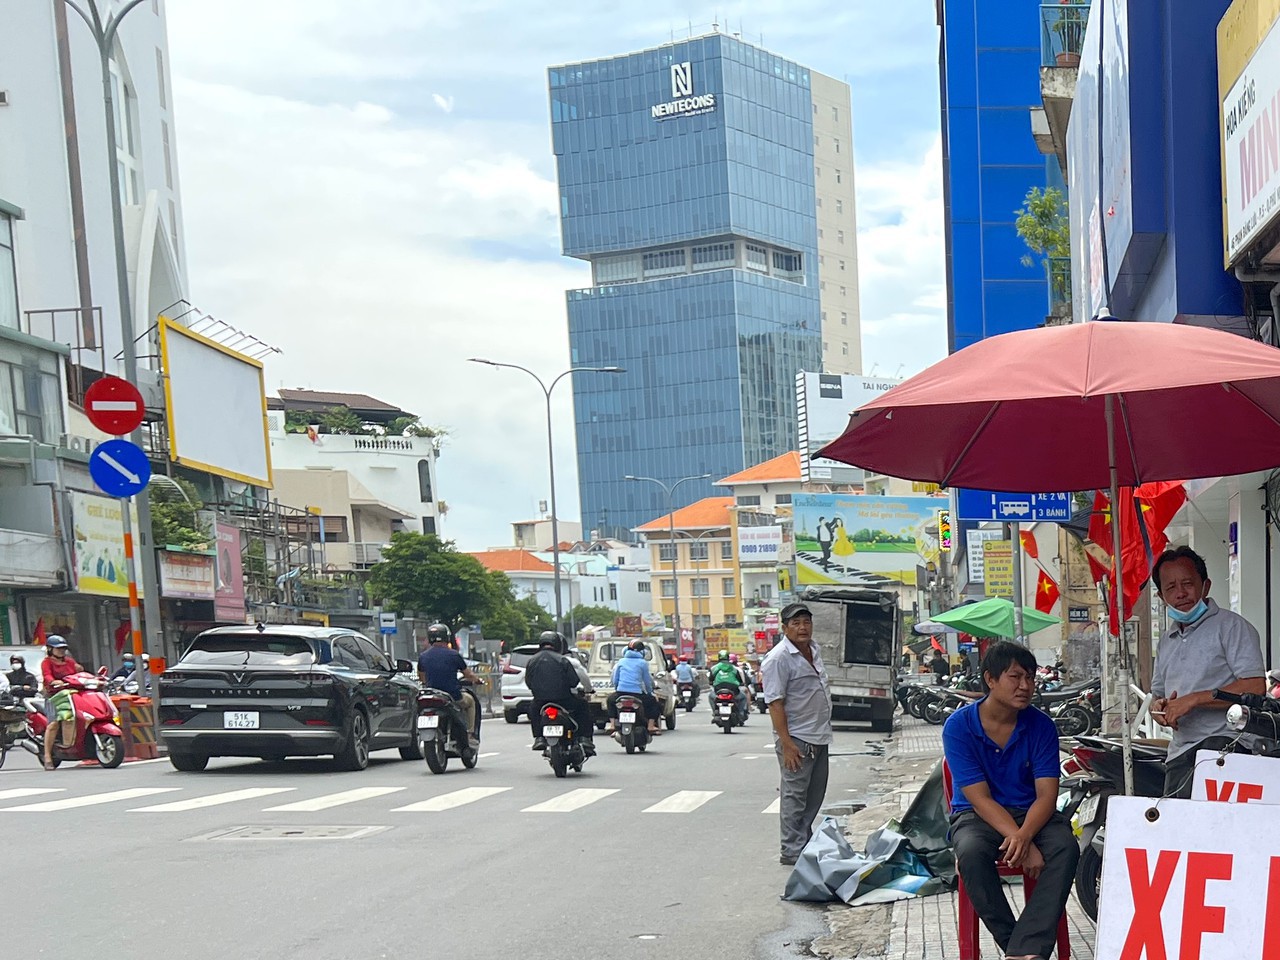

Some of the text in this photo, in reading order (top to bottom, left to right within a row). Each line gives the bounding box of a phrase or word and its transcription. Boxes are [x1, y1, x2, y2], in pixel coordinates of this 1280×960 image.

[651, 93, 715, 118] NEWTECONS
[1226, 106, 1238, 141] HOA
[1038, 507, 1066, 517] 3 BÁNH
[233, 713, 249, 721] 51K
